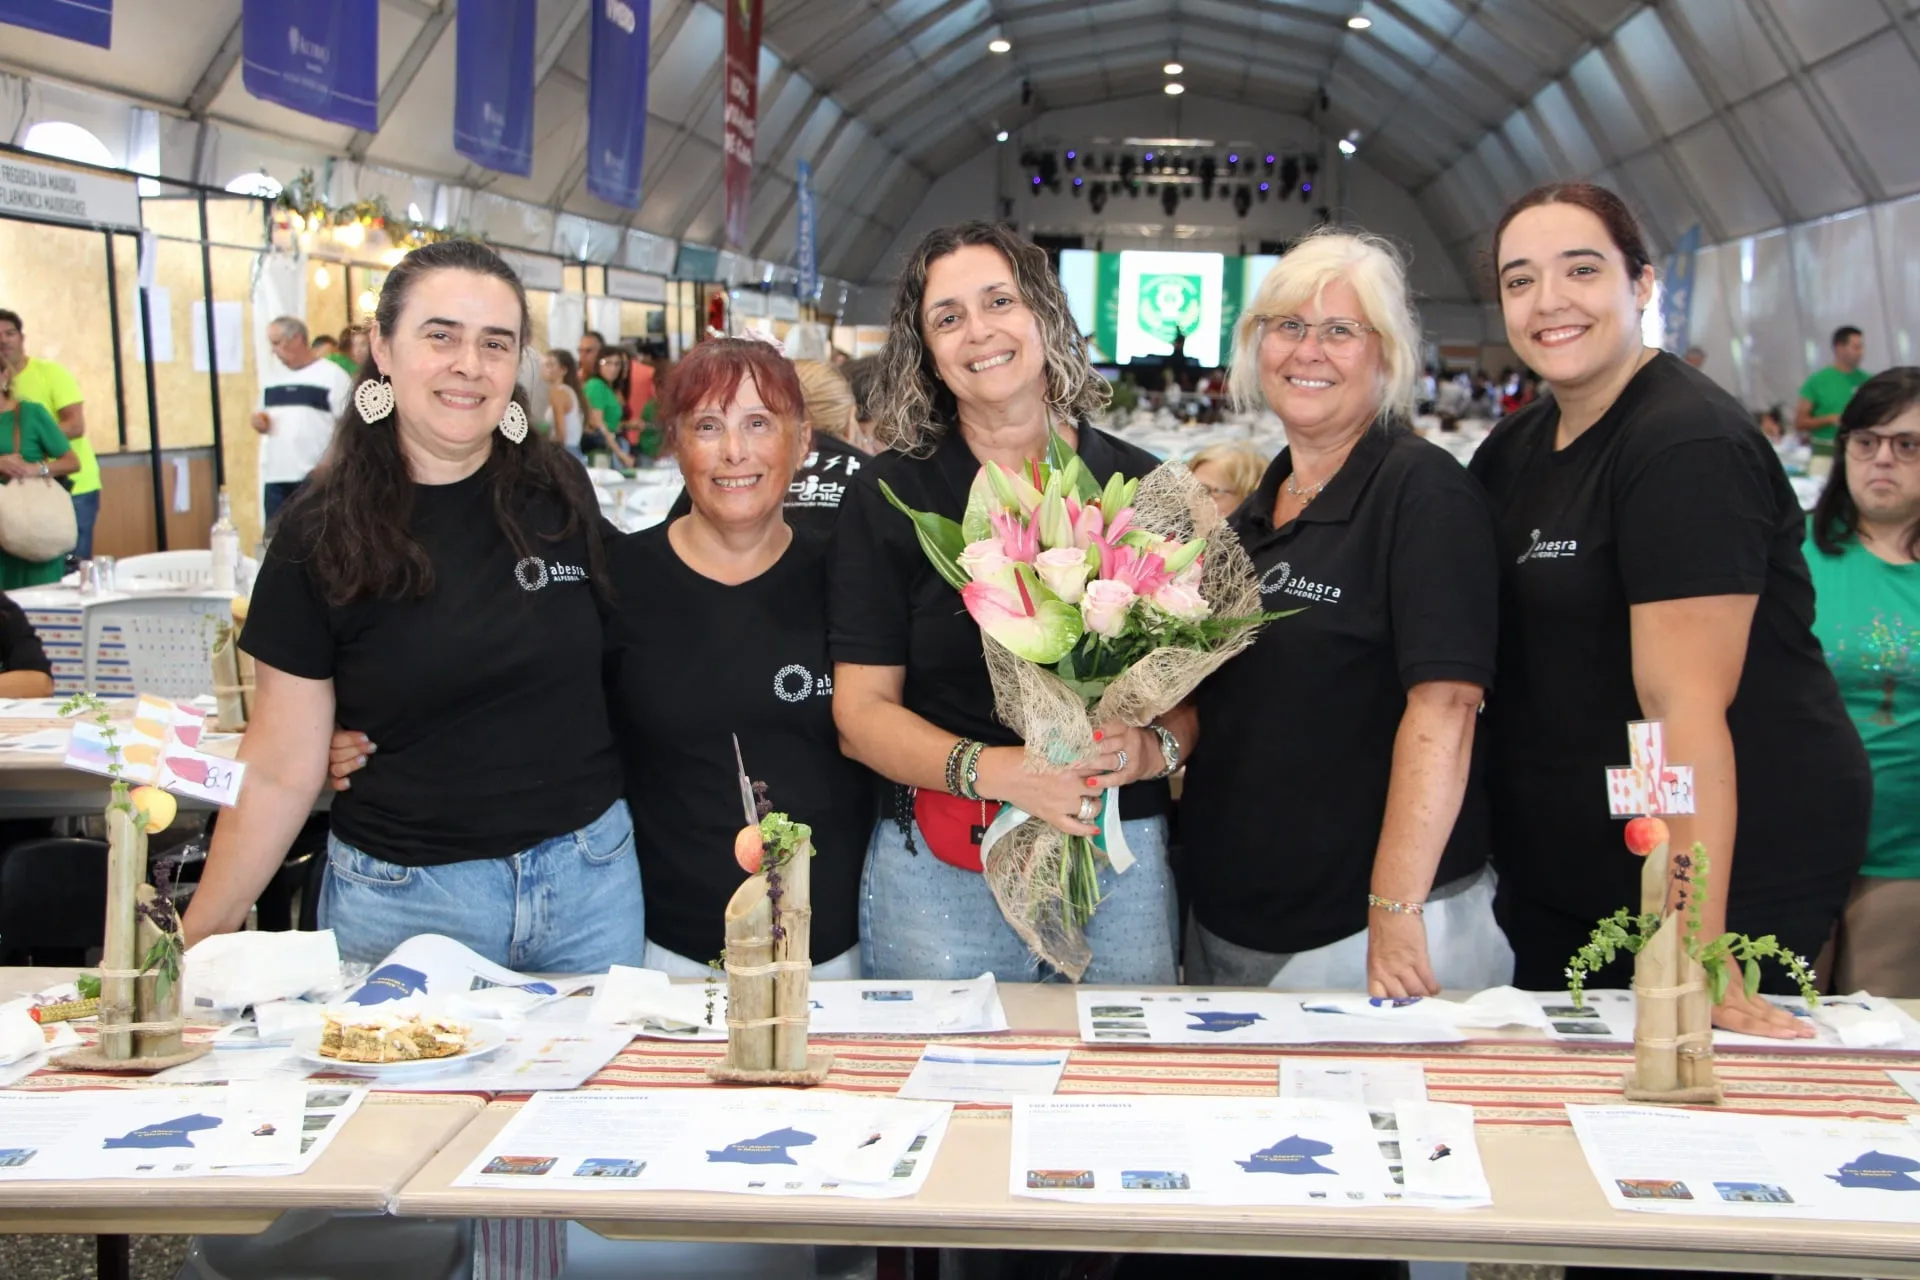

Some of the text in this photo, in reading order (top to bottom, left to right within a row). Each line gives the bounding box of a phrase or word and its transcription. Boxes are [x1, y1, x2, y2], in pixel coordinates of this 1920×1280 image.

[1283, 587, 1322, 601] ALPEDRIZ
[1288, 575, 1342, 599] abesra
[816, 673, 832, 688] ab
